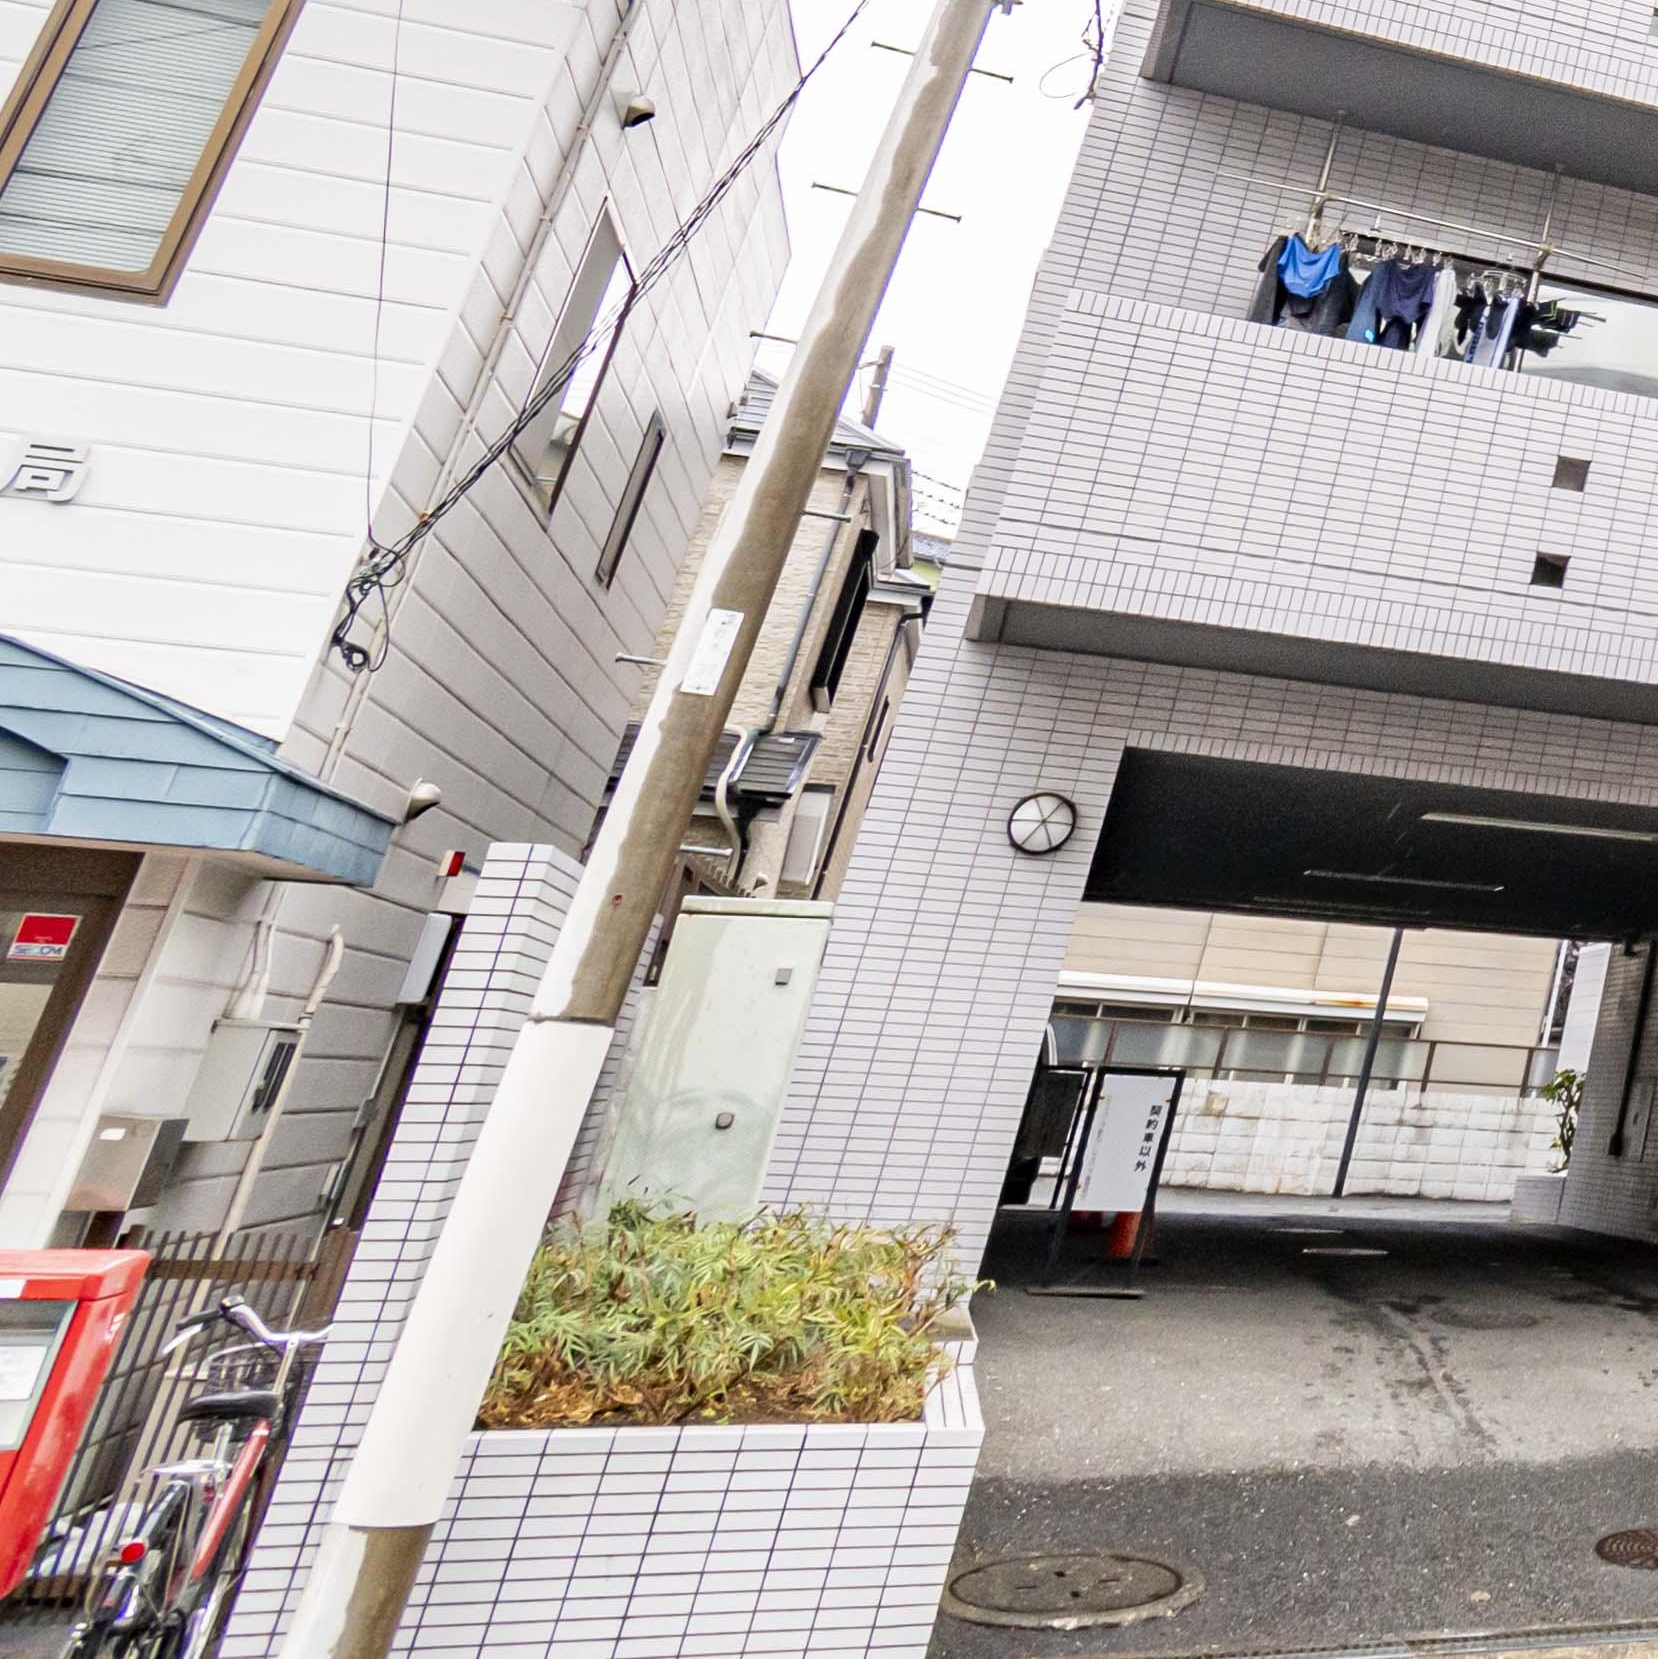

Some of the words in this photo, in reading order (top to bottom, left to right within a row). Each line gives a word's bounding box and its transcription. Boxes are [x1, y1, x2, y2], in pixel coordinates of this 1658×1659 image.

[1133, 1105, 1163, 1172] 契約車以外
